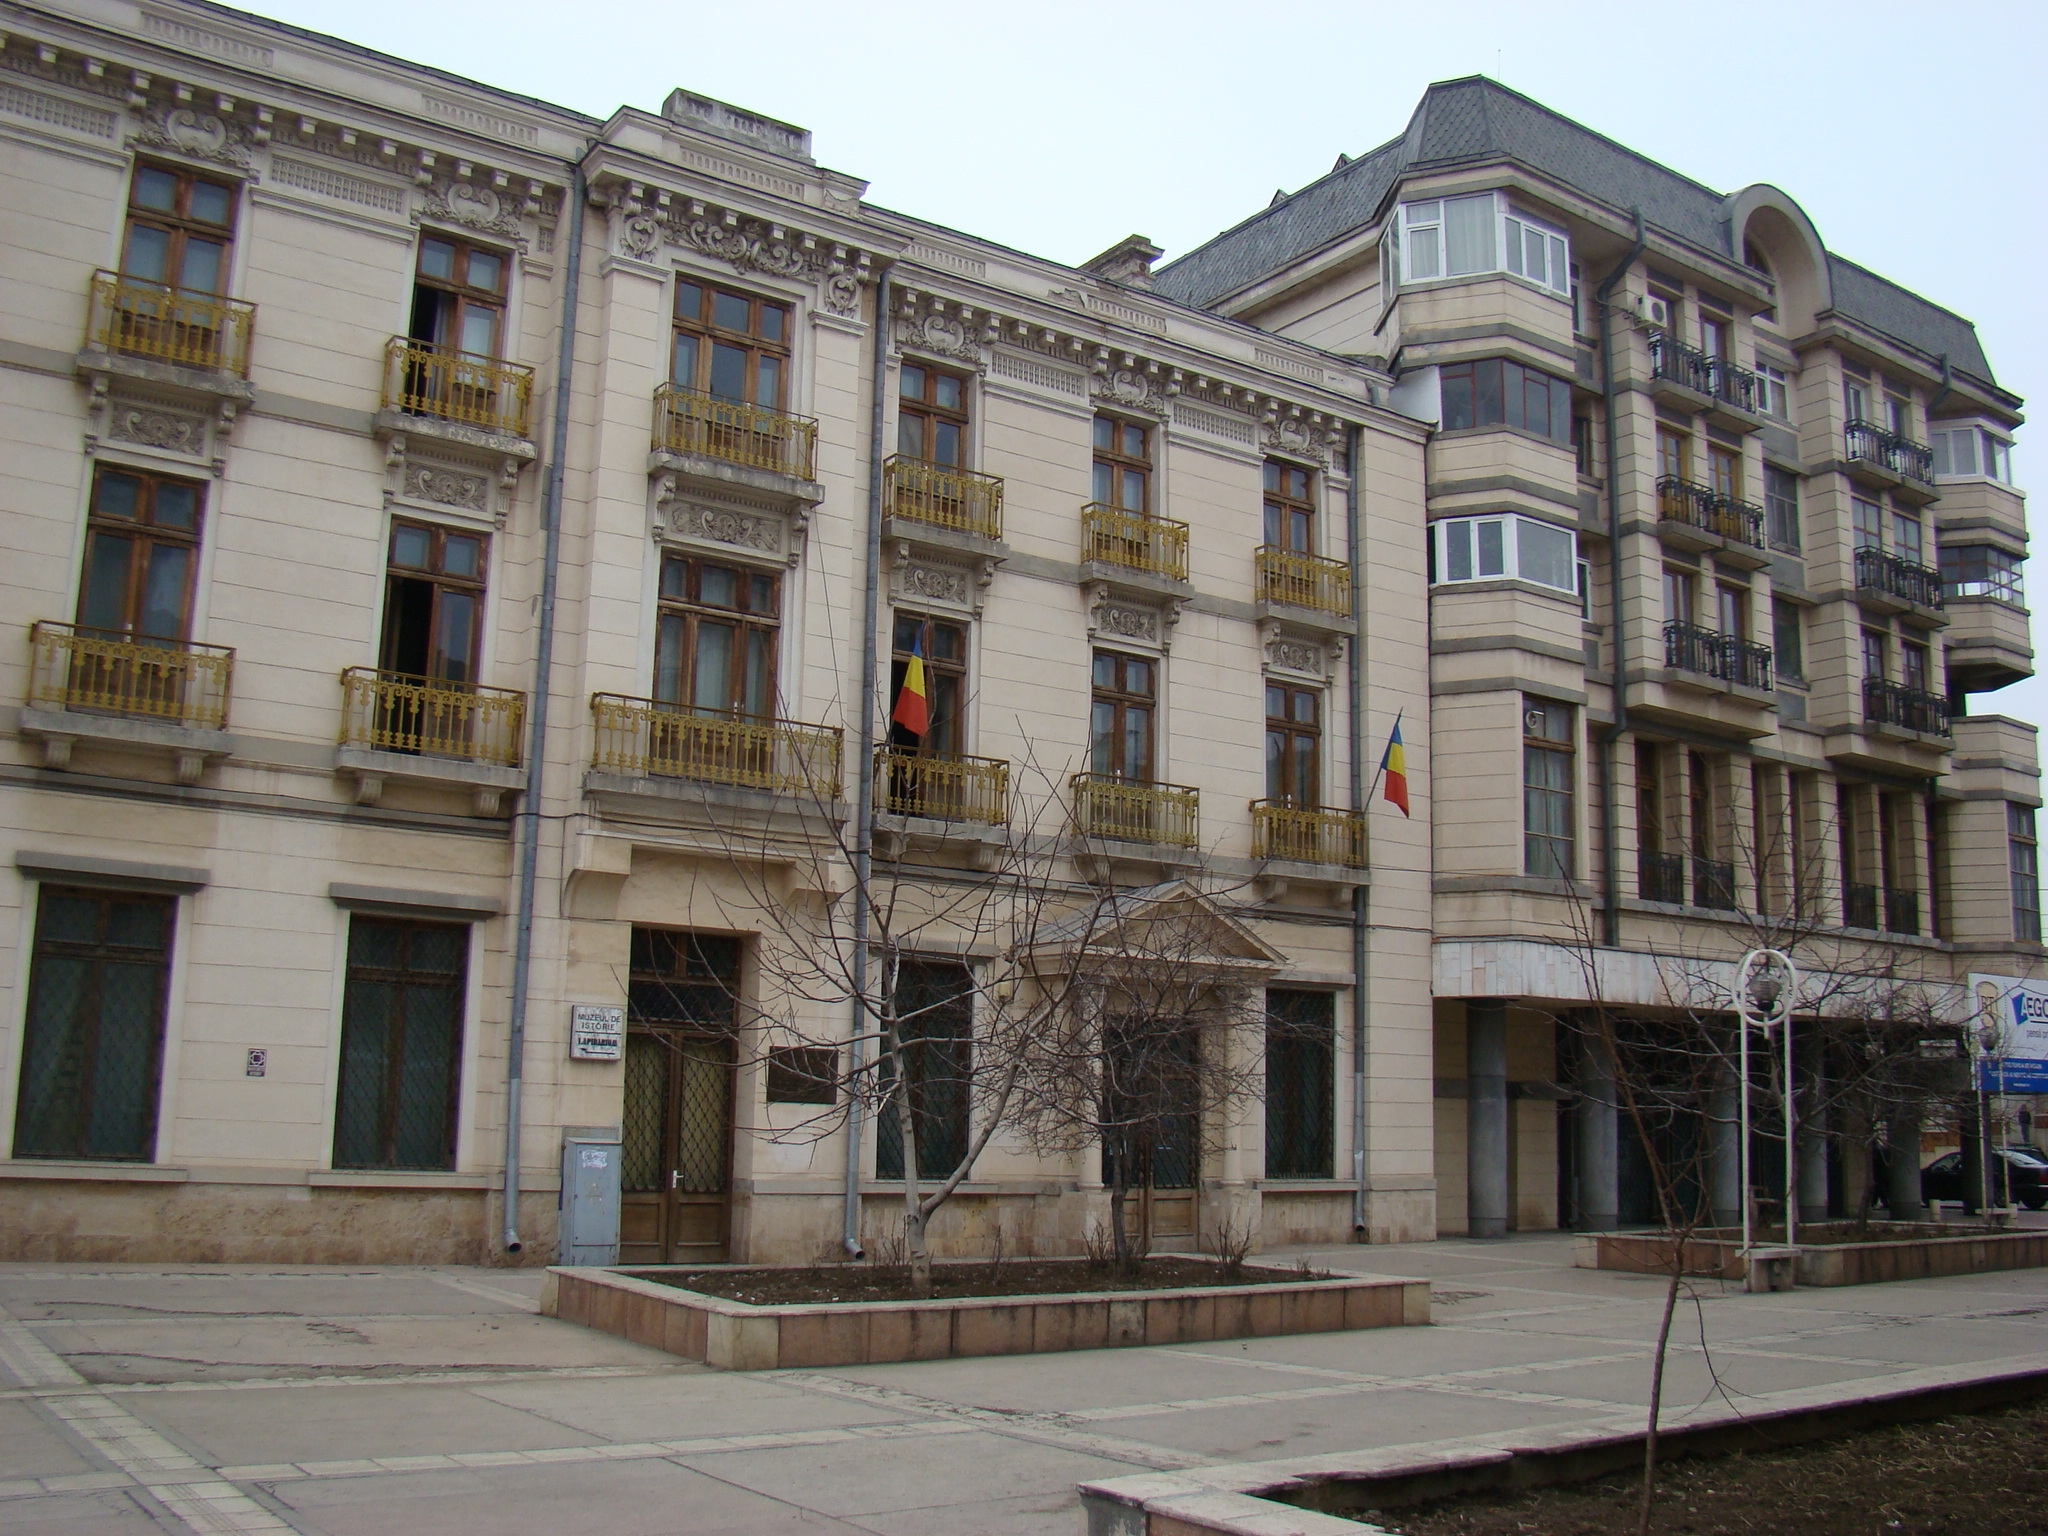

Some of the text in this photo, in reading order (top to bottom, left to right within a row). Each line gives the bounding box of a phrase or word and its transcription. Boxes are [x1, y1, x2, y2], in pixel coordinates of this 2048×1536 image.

[578, 1013, 621, 1023] MUZEUL DE
[581, 1022, 615, 1031] ISTORIE
